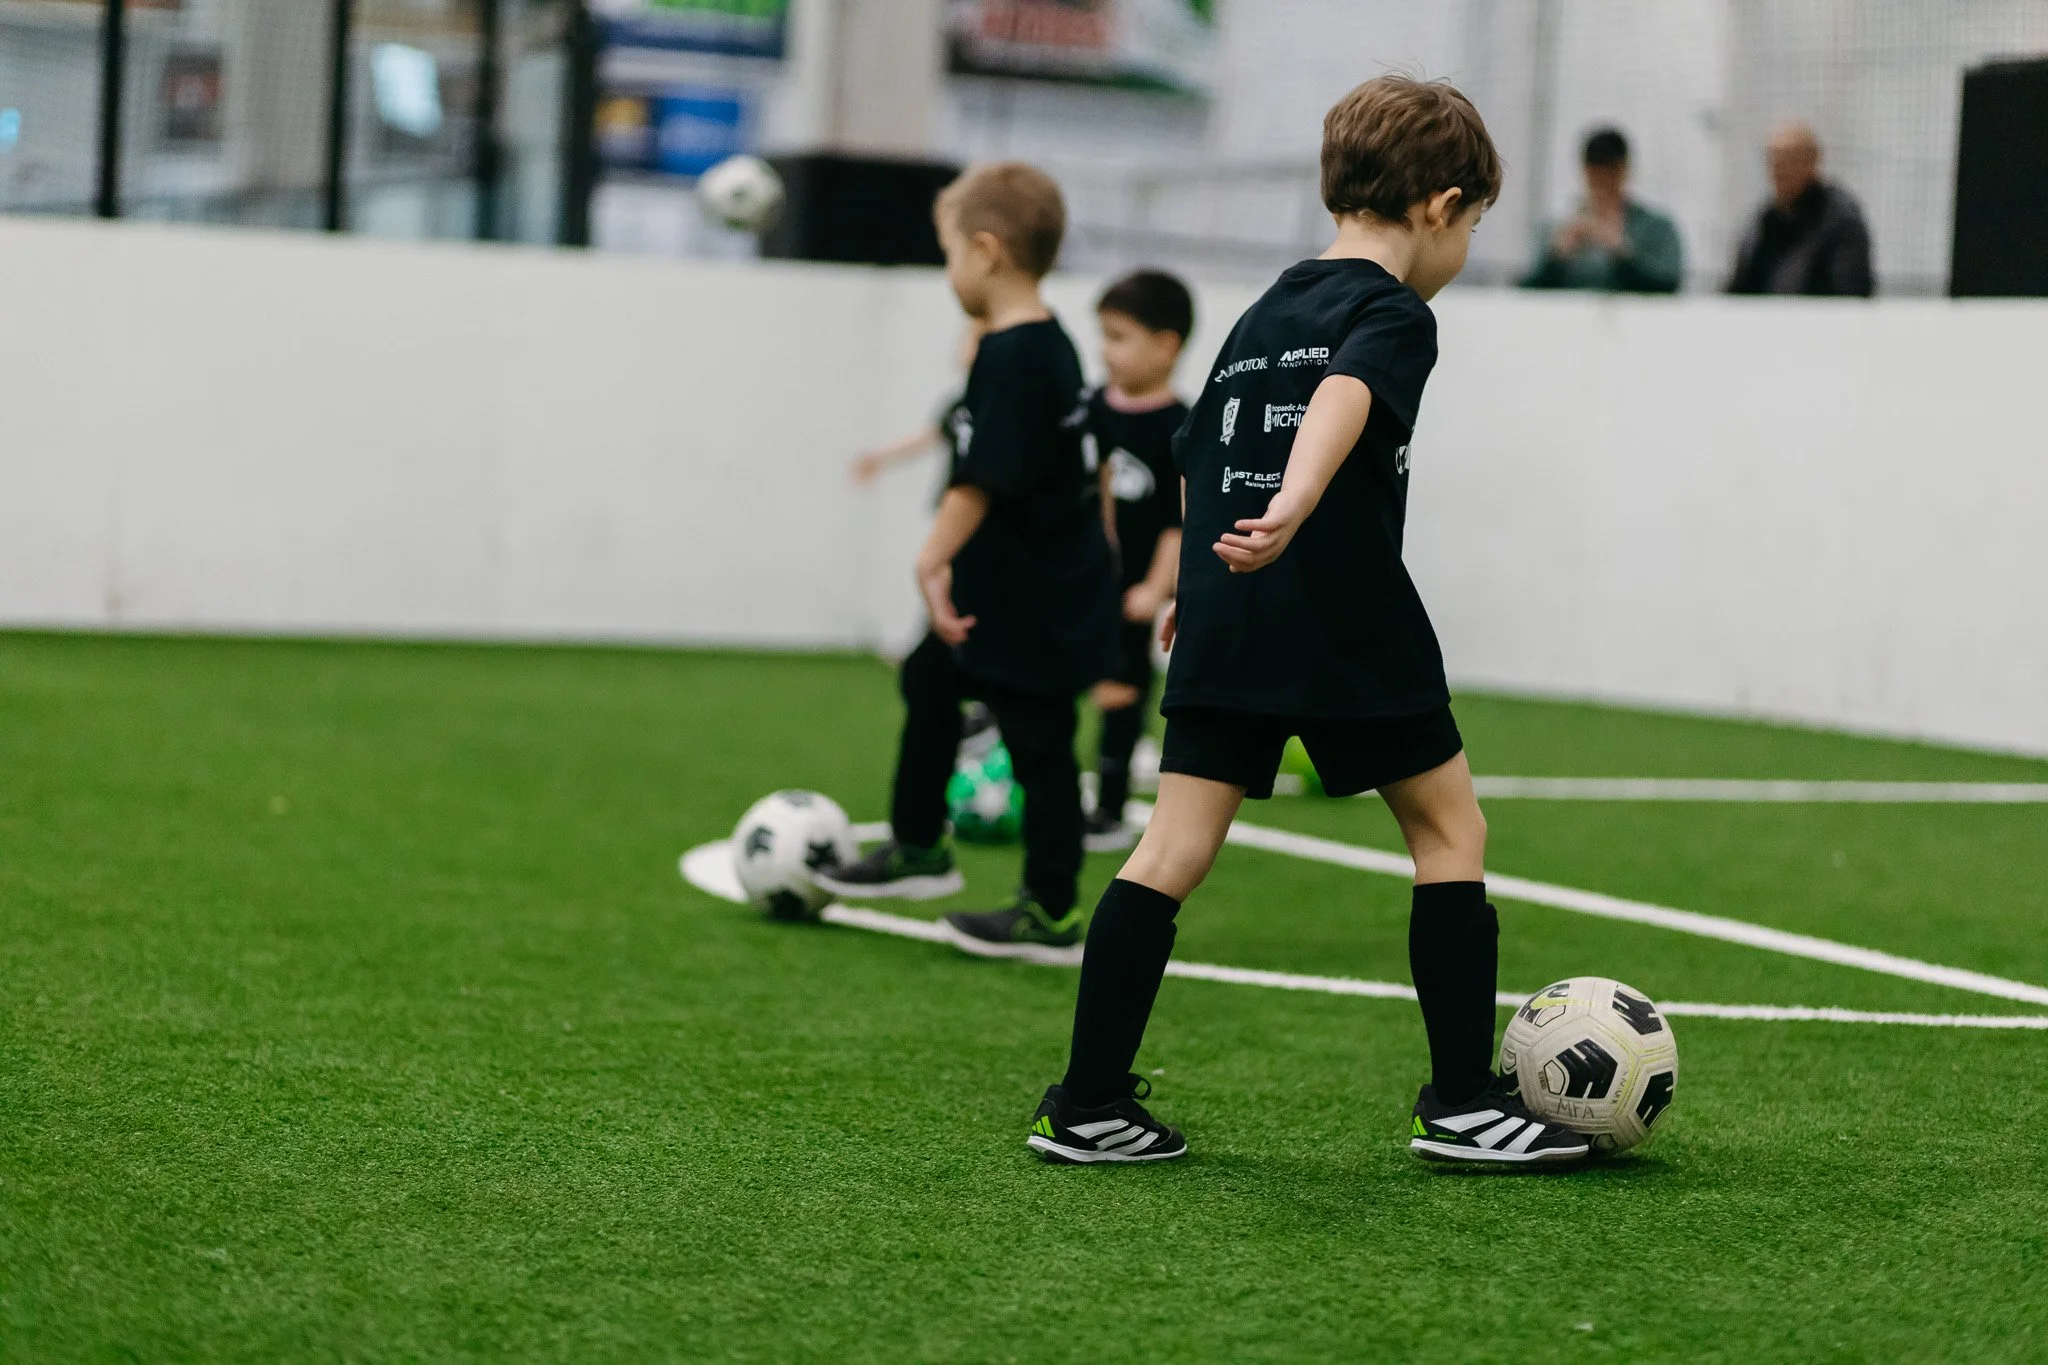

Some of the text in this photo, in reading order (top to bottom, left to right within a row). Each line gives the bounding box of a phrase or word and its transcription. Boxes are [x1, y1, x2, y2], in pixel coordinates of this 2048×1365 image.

[1280, 347, 1330, 361] APPLIED
[1277, 358, 1330, 368] INNOVATION
[1271, 412, 1303, 427] MICHI
